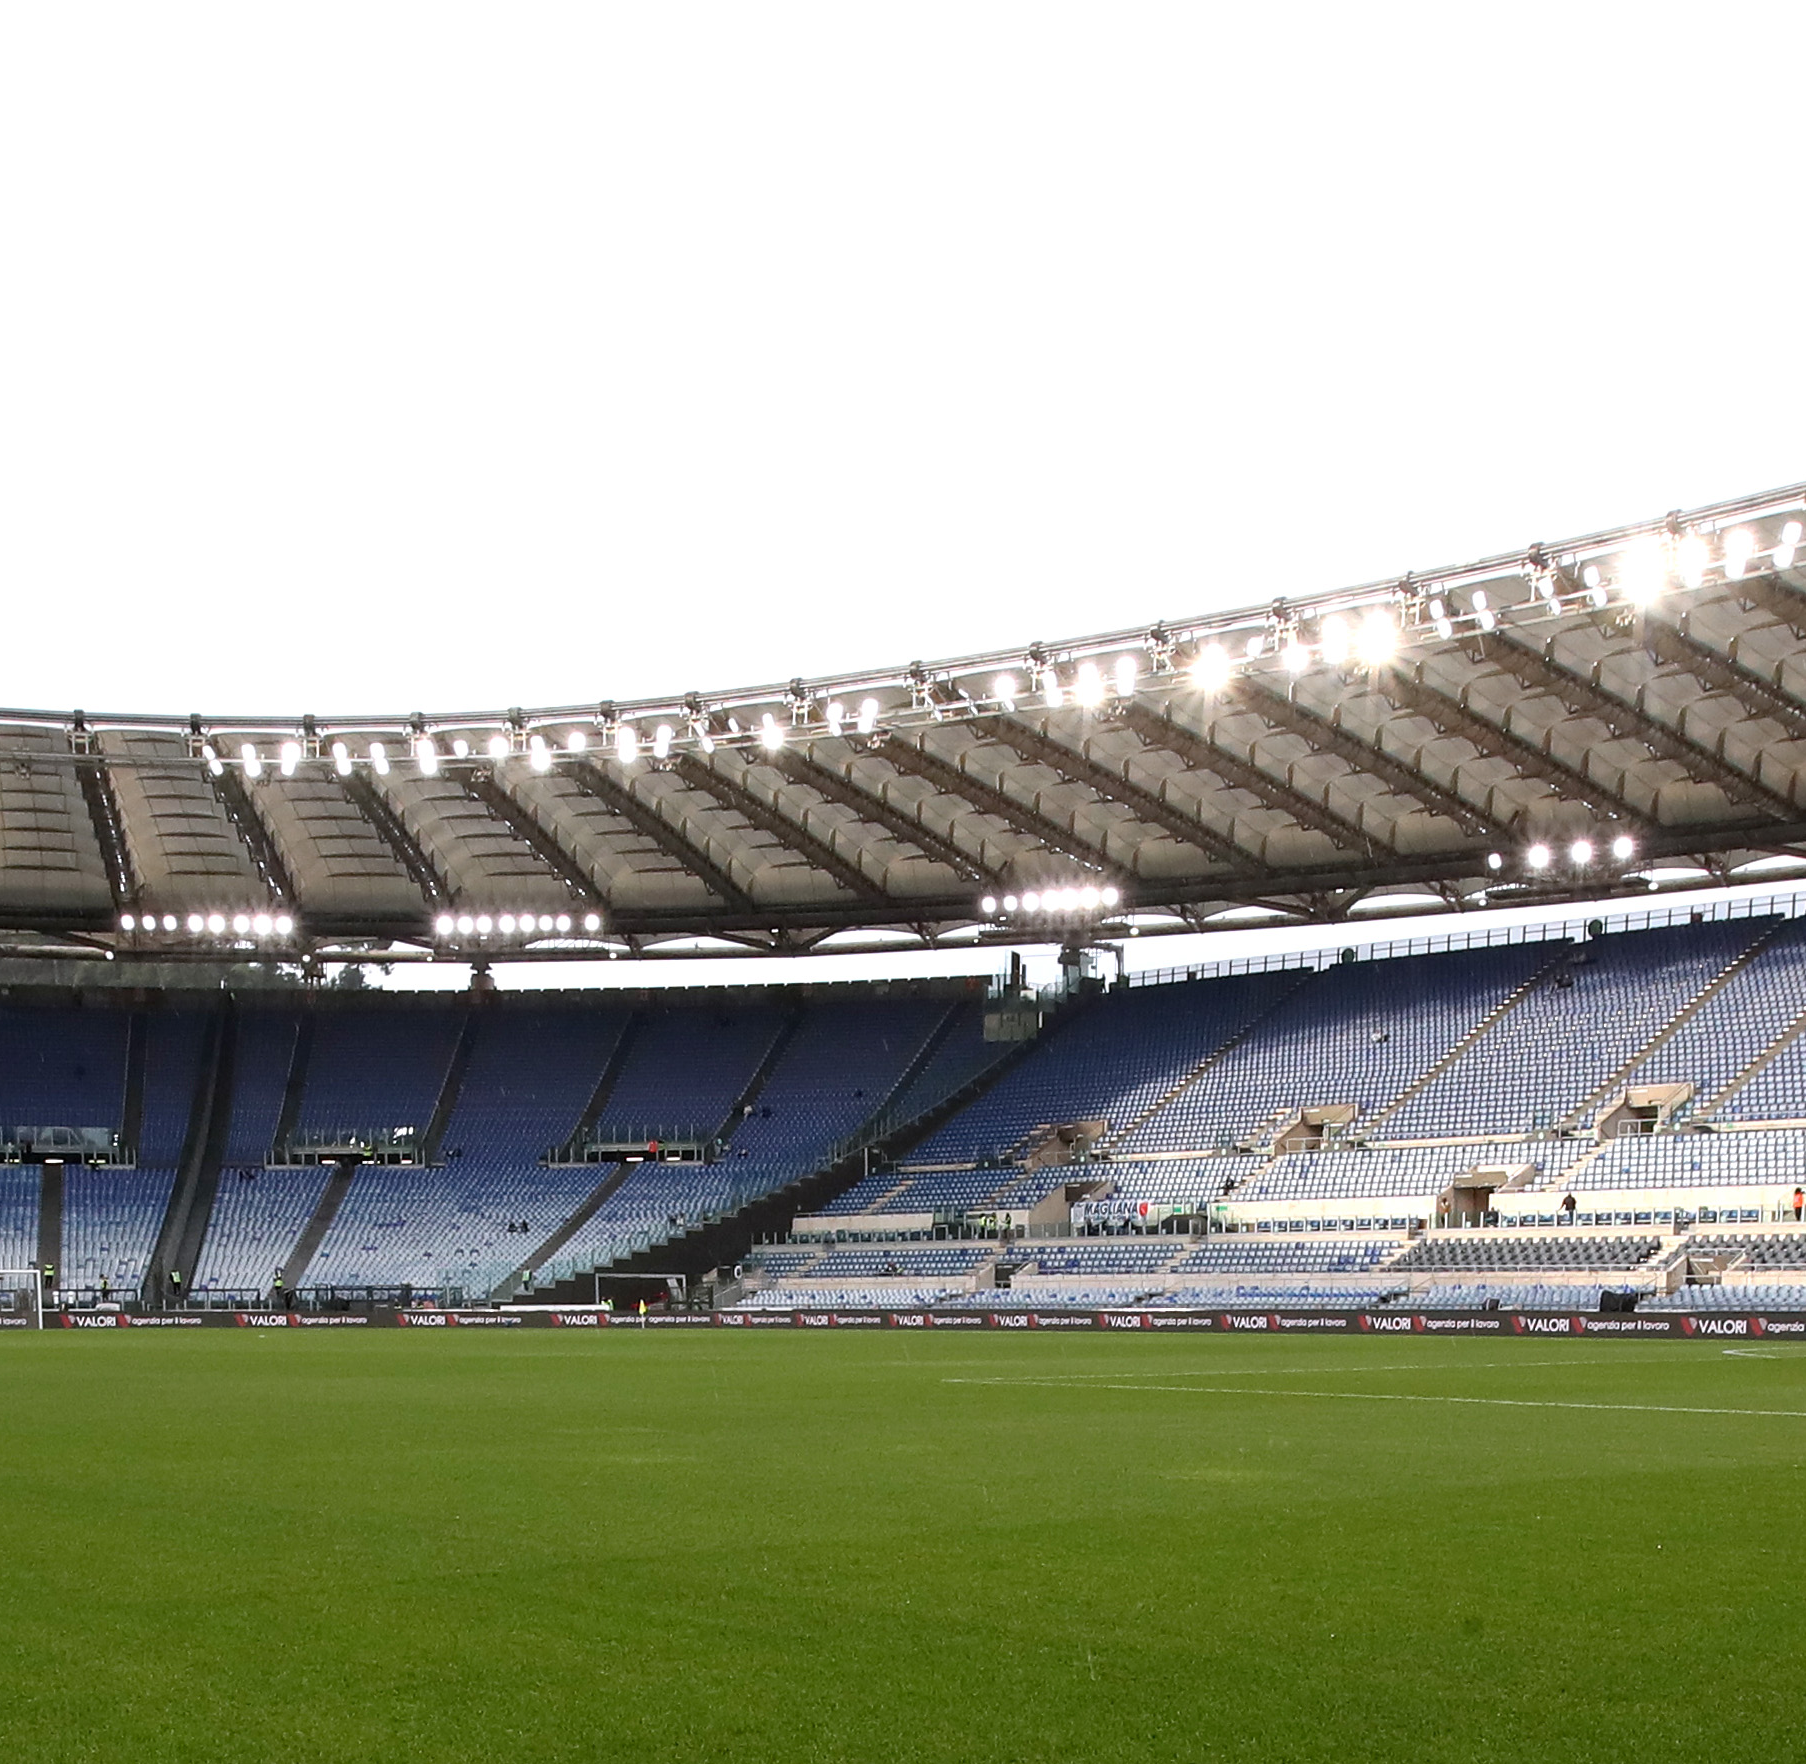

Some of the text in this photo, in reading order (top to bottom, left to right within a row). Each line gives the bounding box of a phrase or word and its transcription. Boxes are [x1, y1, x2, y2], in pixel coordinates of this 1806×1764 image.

[1084, 1201, 1138, 1216] MAGLIANA
[77, 1316, 115, 1326] VALORI
[250, 1316, 286, 1325] VALORI
[411, 1315, 445, 1325] VALORI
[564, 1315, 597, 1325] VALORI
[999, 1316, 1027, 1326] VALORI
[1110, 1316, 1141, 1327] VALORI
[1233, 1317, 1267, 1328] VALORI
[1373, 1318, 1411, 1329] VALORI
[1527, 1319, 1569, 1331] VALORI
[1699, 1320, 1747, 1333] VALORI
